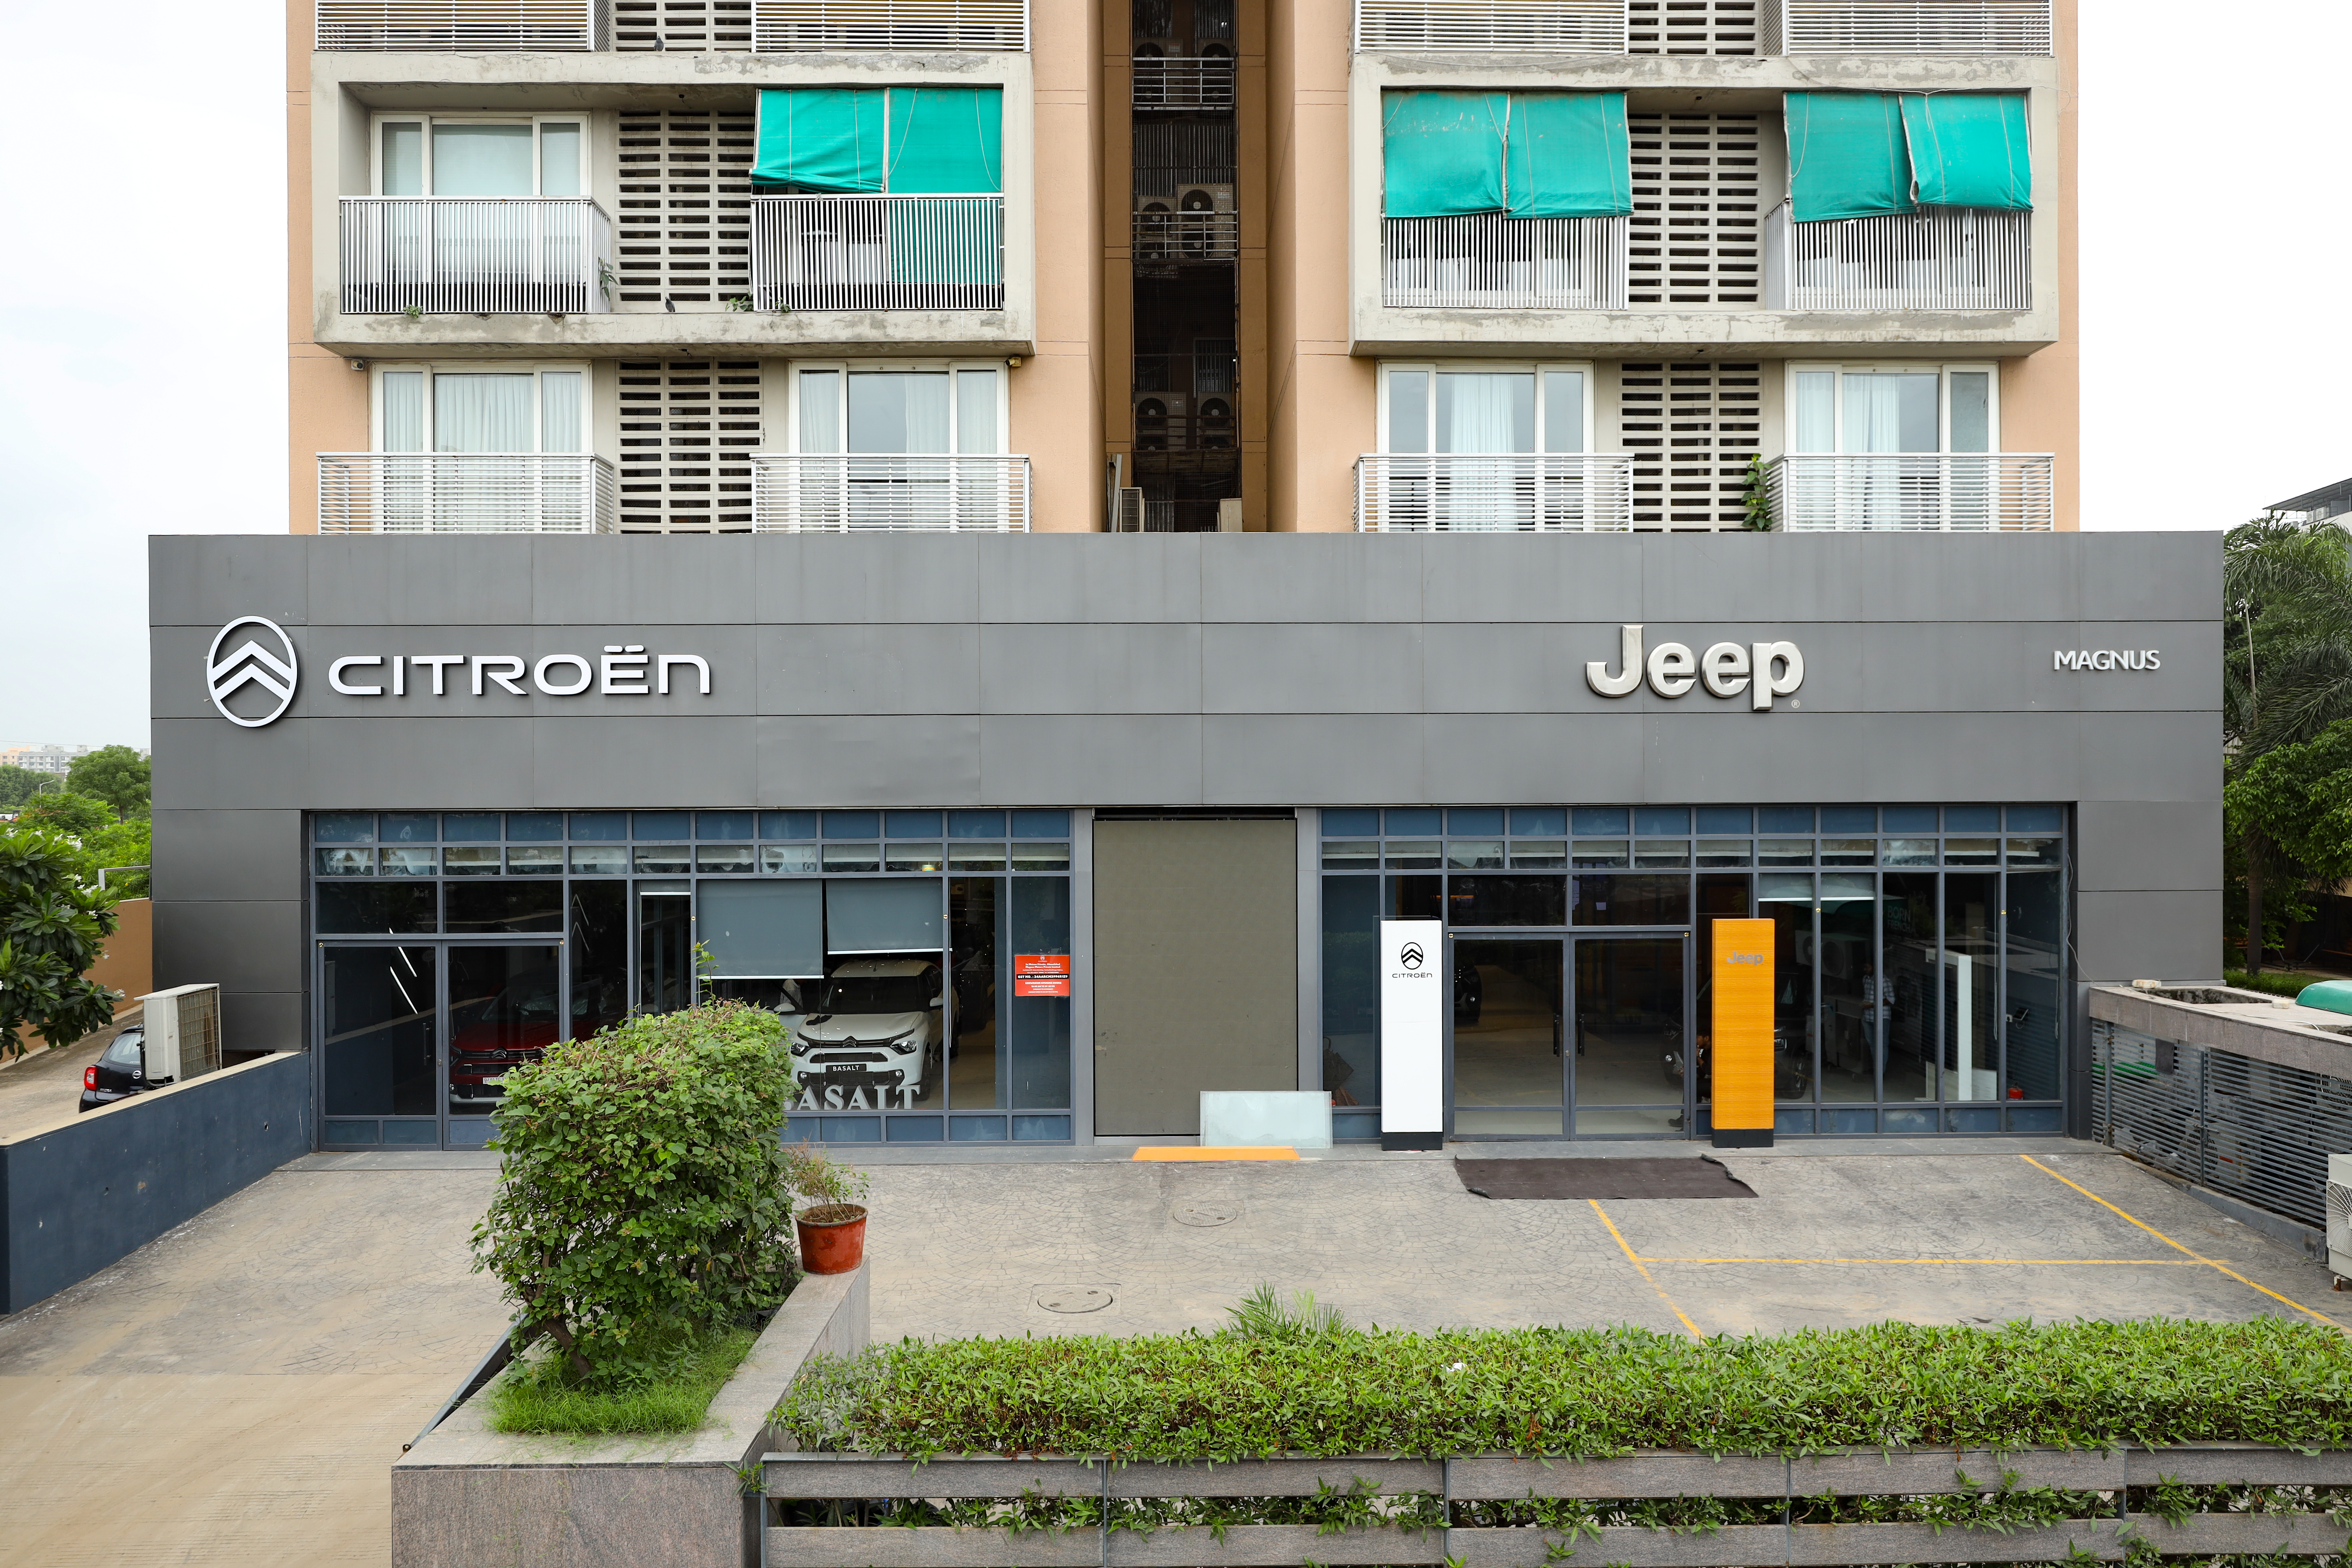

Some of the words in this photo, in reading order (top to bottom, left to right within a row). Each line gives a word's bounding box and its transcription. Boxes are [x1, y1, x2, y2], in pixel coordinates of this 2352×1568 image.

[1587, 625, 1805, 710] Jeep
[2054, 650, 2161, 670] MAGNUS
[1888, 905, 1911, 922] BORN
[1727, 951, 1763, 966] Jeep
